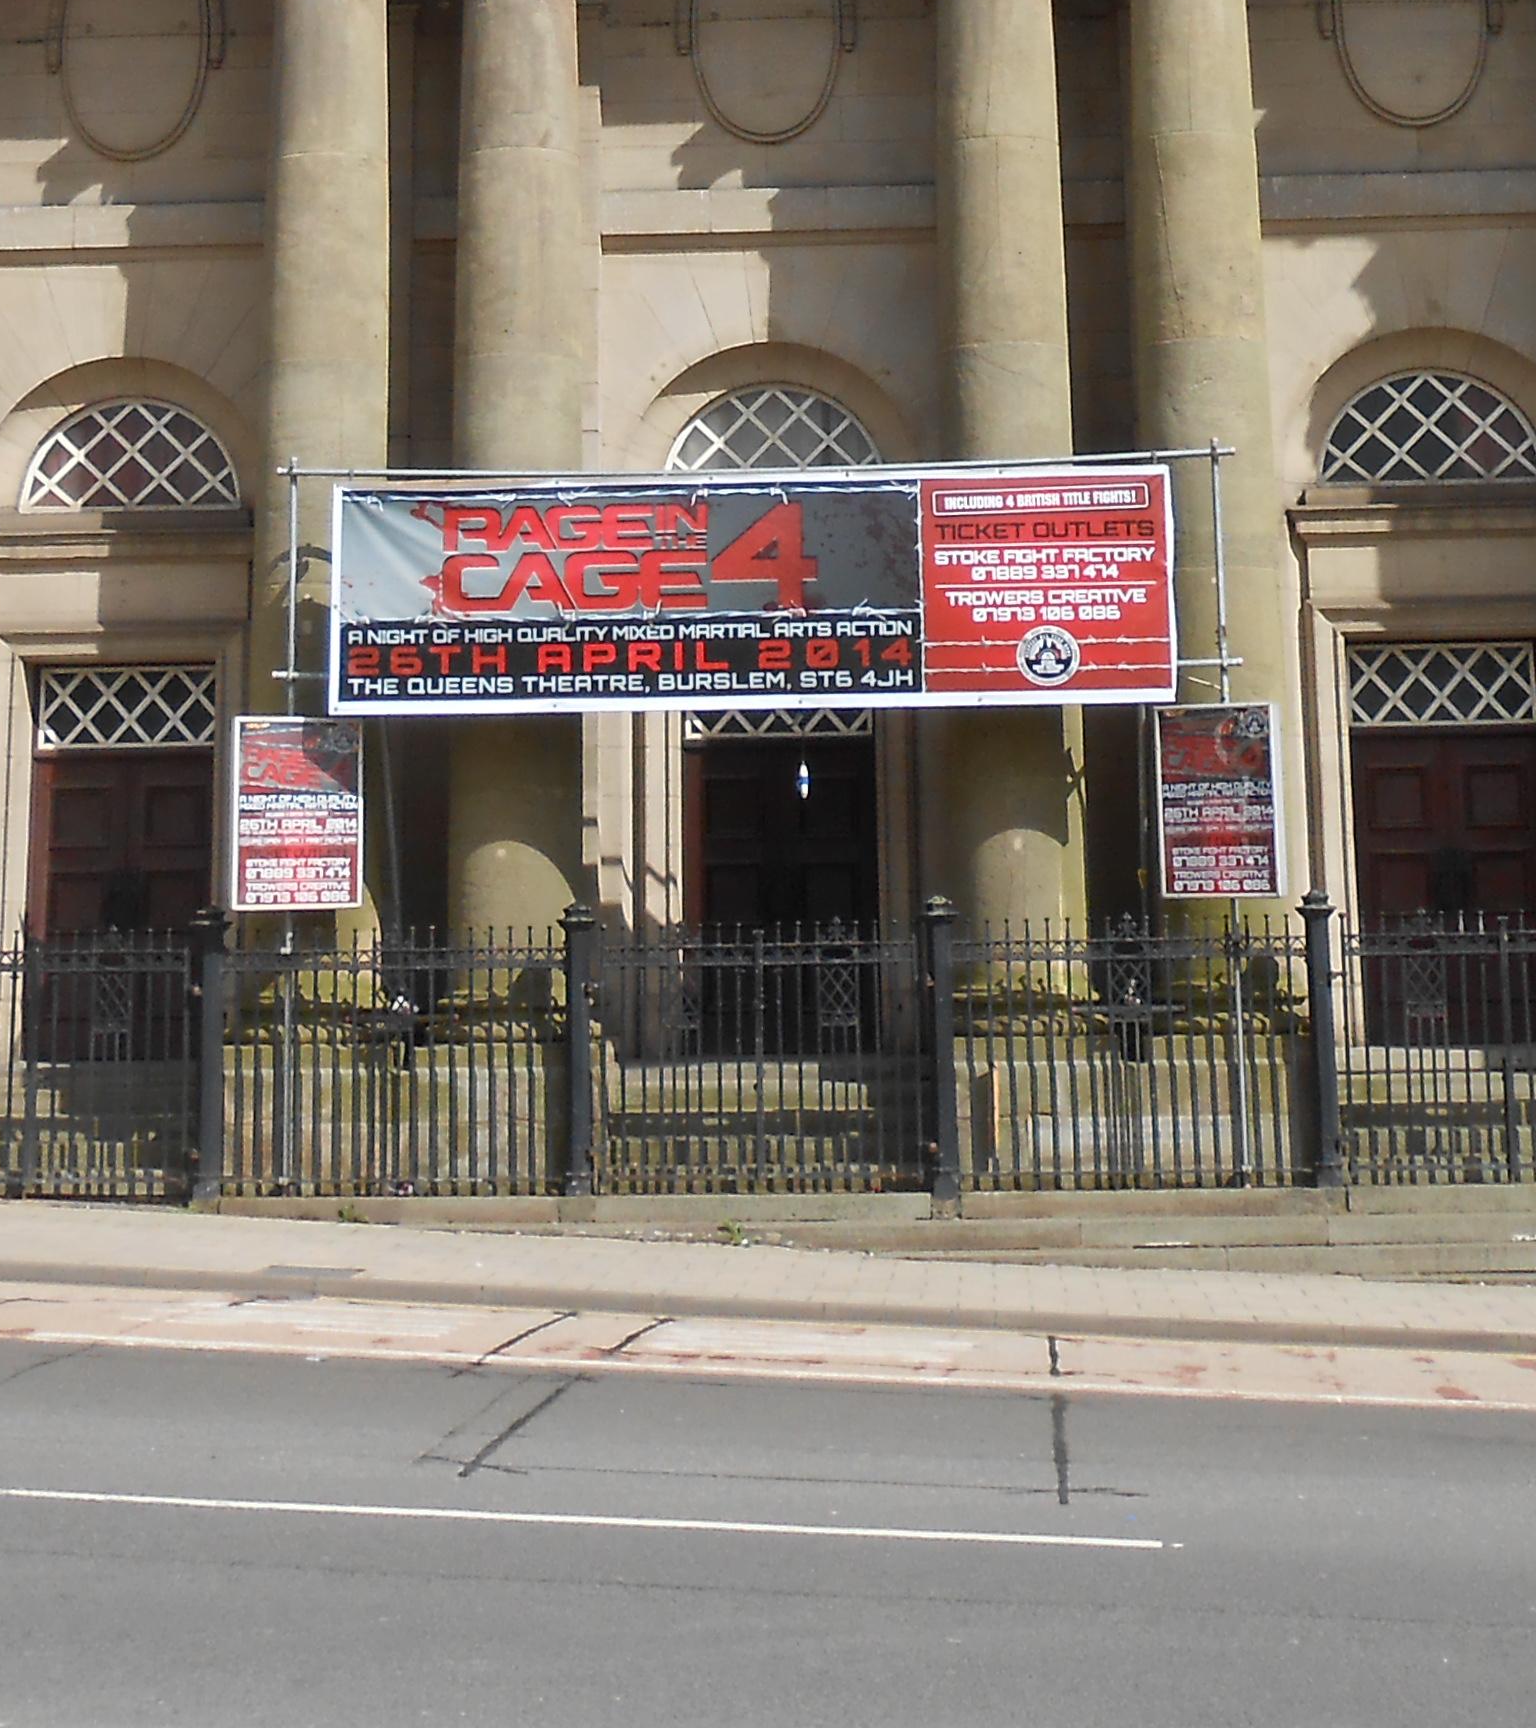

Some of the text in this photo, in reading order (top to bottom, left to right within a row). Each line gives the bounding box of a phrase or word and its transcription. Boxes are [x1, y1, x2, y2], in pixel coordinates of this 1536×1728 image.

[944, 489, 1137, 510] INCLUDING 4 BRITISH TITLE FIGHTS!
[442, 501, 708, 553] RAGE IN
[935, 519, 1155, 540] TICKET OUTLETS
[710, 502, 818, 609] 4
[934, 546, 1155, 565] STOKE FIGHT FACTORY
[440, 549, 708, 614] CAGE
[971, 563, 1119, 581] 07889 337 474
[945, 587, 1147, 606] TROWERS CREATIVE
[972, 605, 1121, 622] 07973 106 086
[348, 620, 913, 645] A NIGHT OF HIGH QUALITY MIXED MARTIAL ARTS ACTION
[348, 637, 913, 676] 26TH APRIL 2014
[348, 669, 913, 695] THE QUEENS THEATRE, BURSLEM, ST6 4JH
